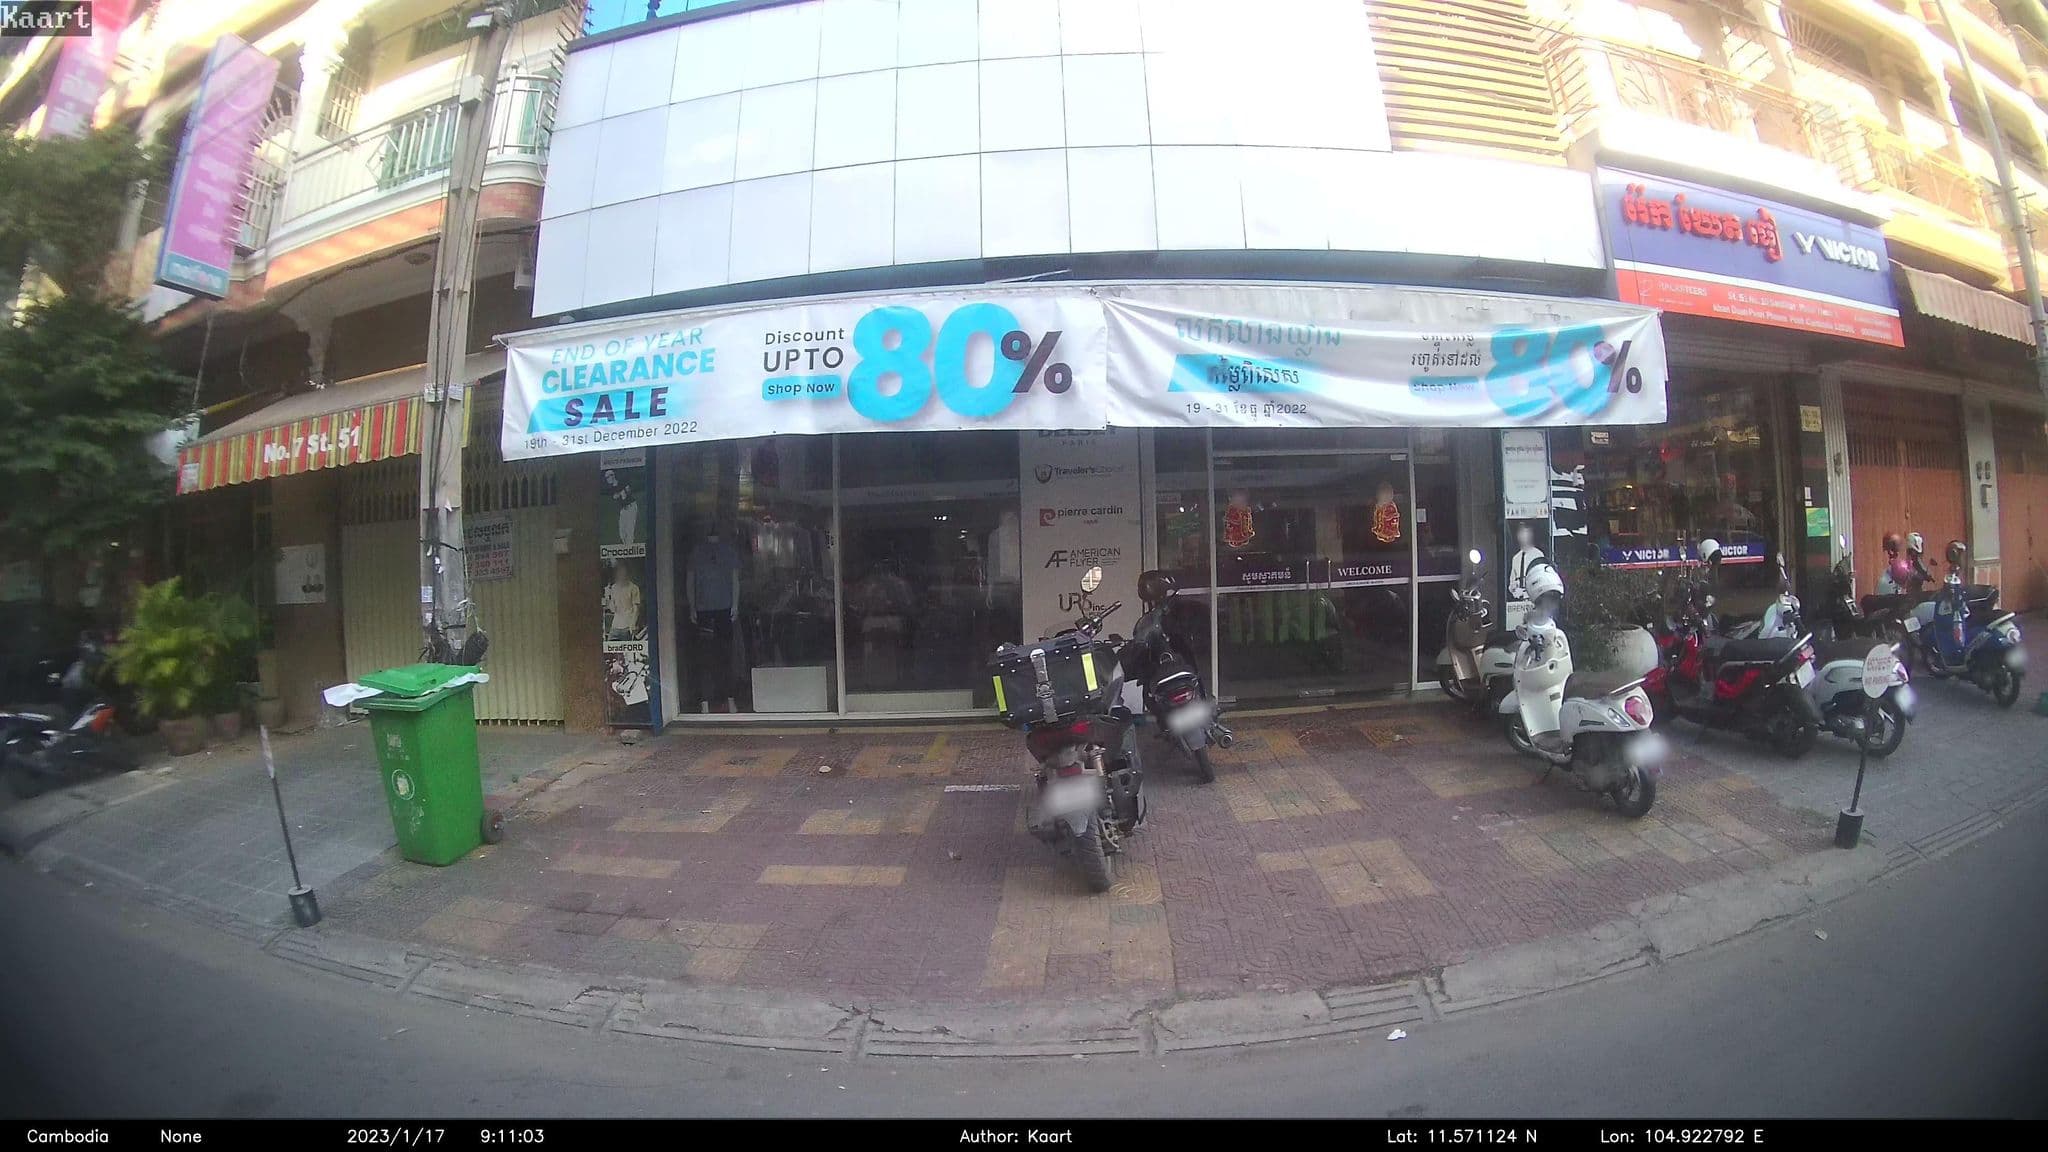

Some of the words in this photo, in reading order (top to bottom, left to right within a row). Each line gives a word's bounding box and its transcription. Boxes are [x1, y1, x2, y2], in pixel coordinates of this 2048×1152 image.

[1817, 236, 1880, 271] VICTOR
[552, 344, 595, 365] END
[605, 338, 635, 357] OF
[644, 327, 703, 349] YEAR
[764, 326, 845, 347] Discount
[763, 345, 844, 373] UPTO
[847, 302, 1074, 423] 80%
[542, 348, 716, 394] CLEARANCE
[1486, 322, 1642, 418] 80%
[767, 381, 803, 396] Shop
[806, 382, 836, 395] Now
[564, 386, 669, 427] SALE
[1186, 402, 1201, 414] 19
[264, 442, 290, 463] No.
[292, 438, 302, 458] 7
[307, 434, 333, 455] St.
[338, 426, 360, 449] 51
[524, 437, 547, 450] 19th
[562, 433, 588, 447] 31st
[593, 426, 658, 443] December
[664, 421, 698, 435] 2022
[1058, 507, 1088, 519] pierre
[1090, 505, 1123, 516] cardin
[601, 547, 645, 557] Crocodile
[1069, 558, 1099, 567] FLYER
[1070, 547, 1121, 558] AMERICAN
[1634, 549, 1671, 561] VICTOR
[1338, 564, 1393, 577] WELCOME
[607, 643, 644, 652] bradFORD
